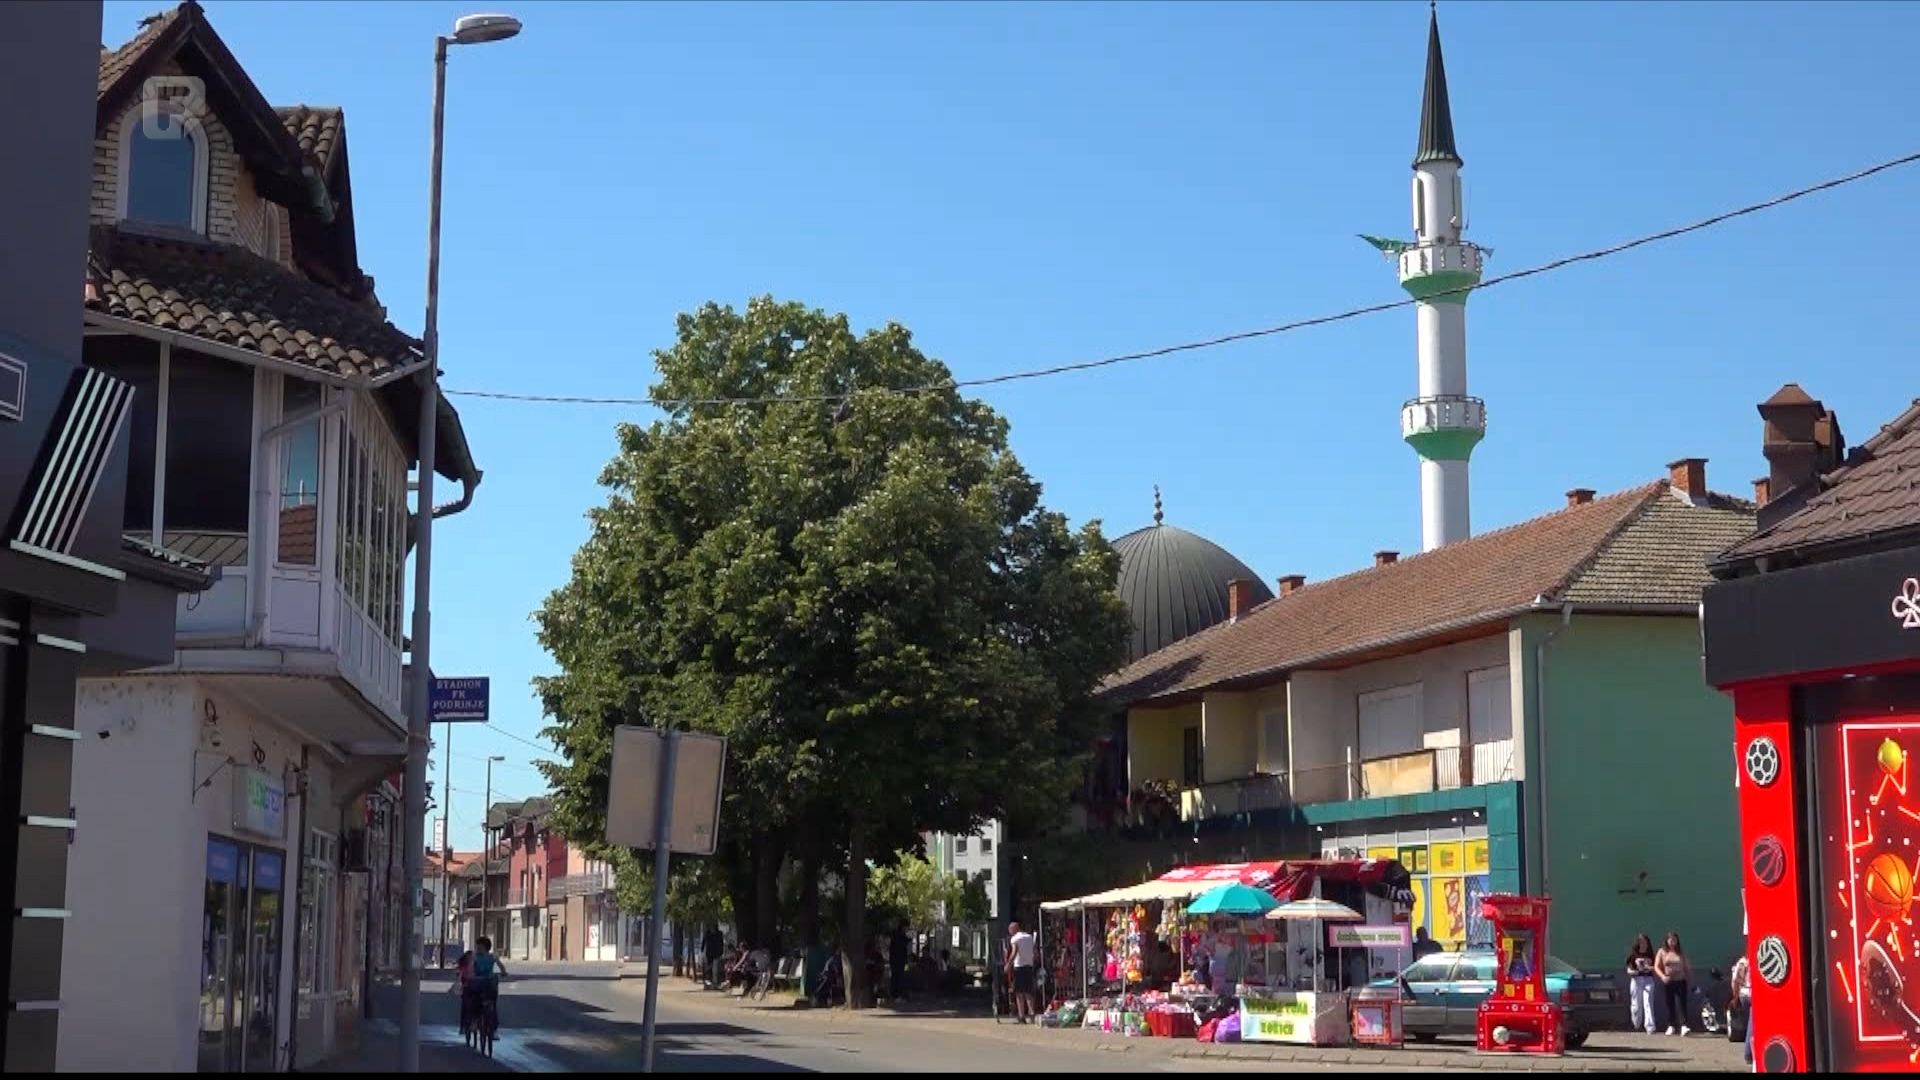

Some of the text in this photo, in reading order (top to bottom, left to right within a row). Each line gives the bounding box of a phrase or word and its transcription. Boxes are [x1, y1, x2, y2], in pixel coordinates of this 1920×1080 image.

[436, 680, 481, 689] STADION
[452, 690, 465, 699] FK
[433, 700, 485, 709] PODRINJE
